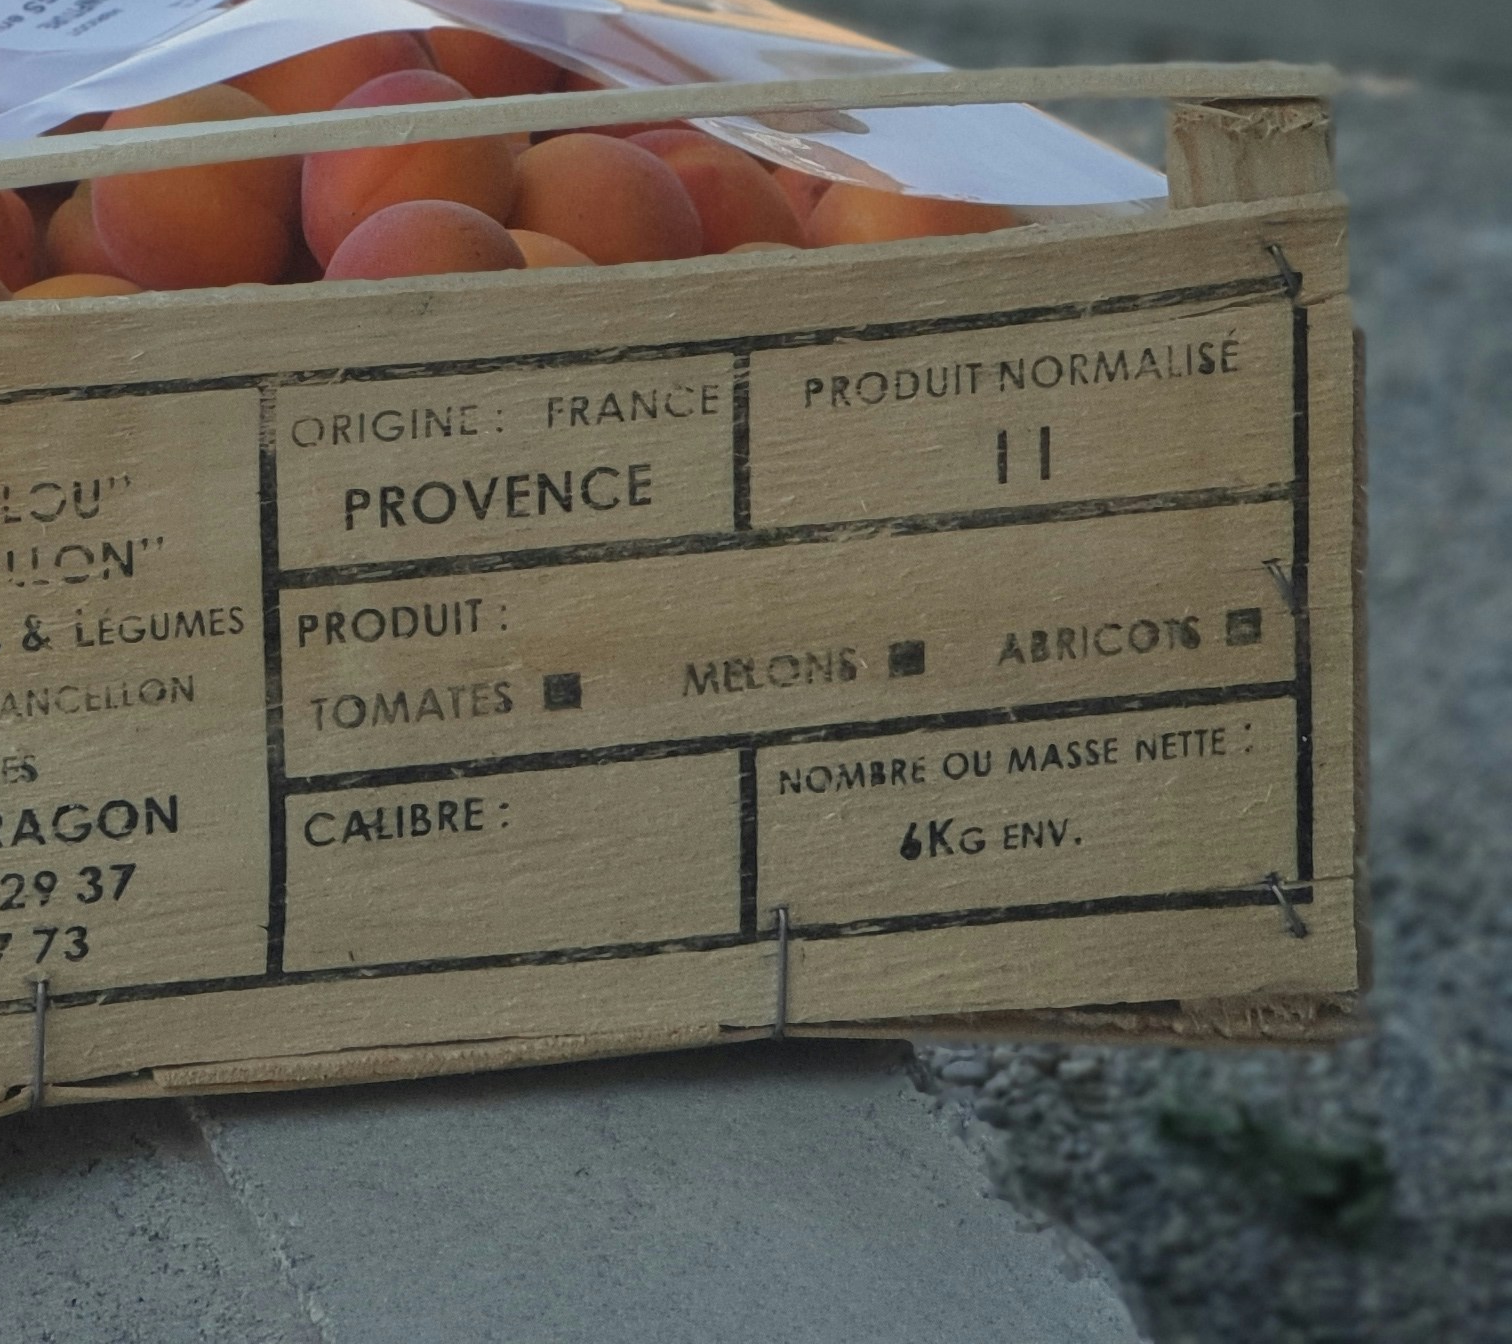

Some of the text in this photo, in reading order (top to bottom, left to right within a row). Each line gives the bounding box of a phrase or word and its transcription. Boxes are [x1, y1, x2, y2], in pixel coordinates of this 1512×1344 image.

[804, 328, 1241, 408] PRODUIT NORMALISÉ
[546, 384, 720, 430] FRANCE
[344, 463, 654, 532] PROVENCE
[21, 613, 52, 651] &
[310, 614, 1202, 732] TOMATES MELONS ABRICOTS
[779, 755, 927, 796] NOMBRE
[942, 750, 992, 781] OU
[1007, 736, 1119, 775] MASSE
[76, 862, 137, 904] 37
[32, 924, 90, 964] 73
